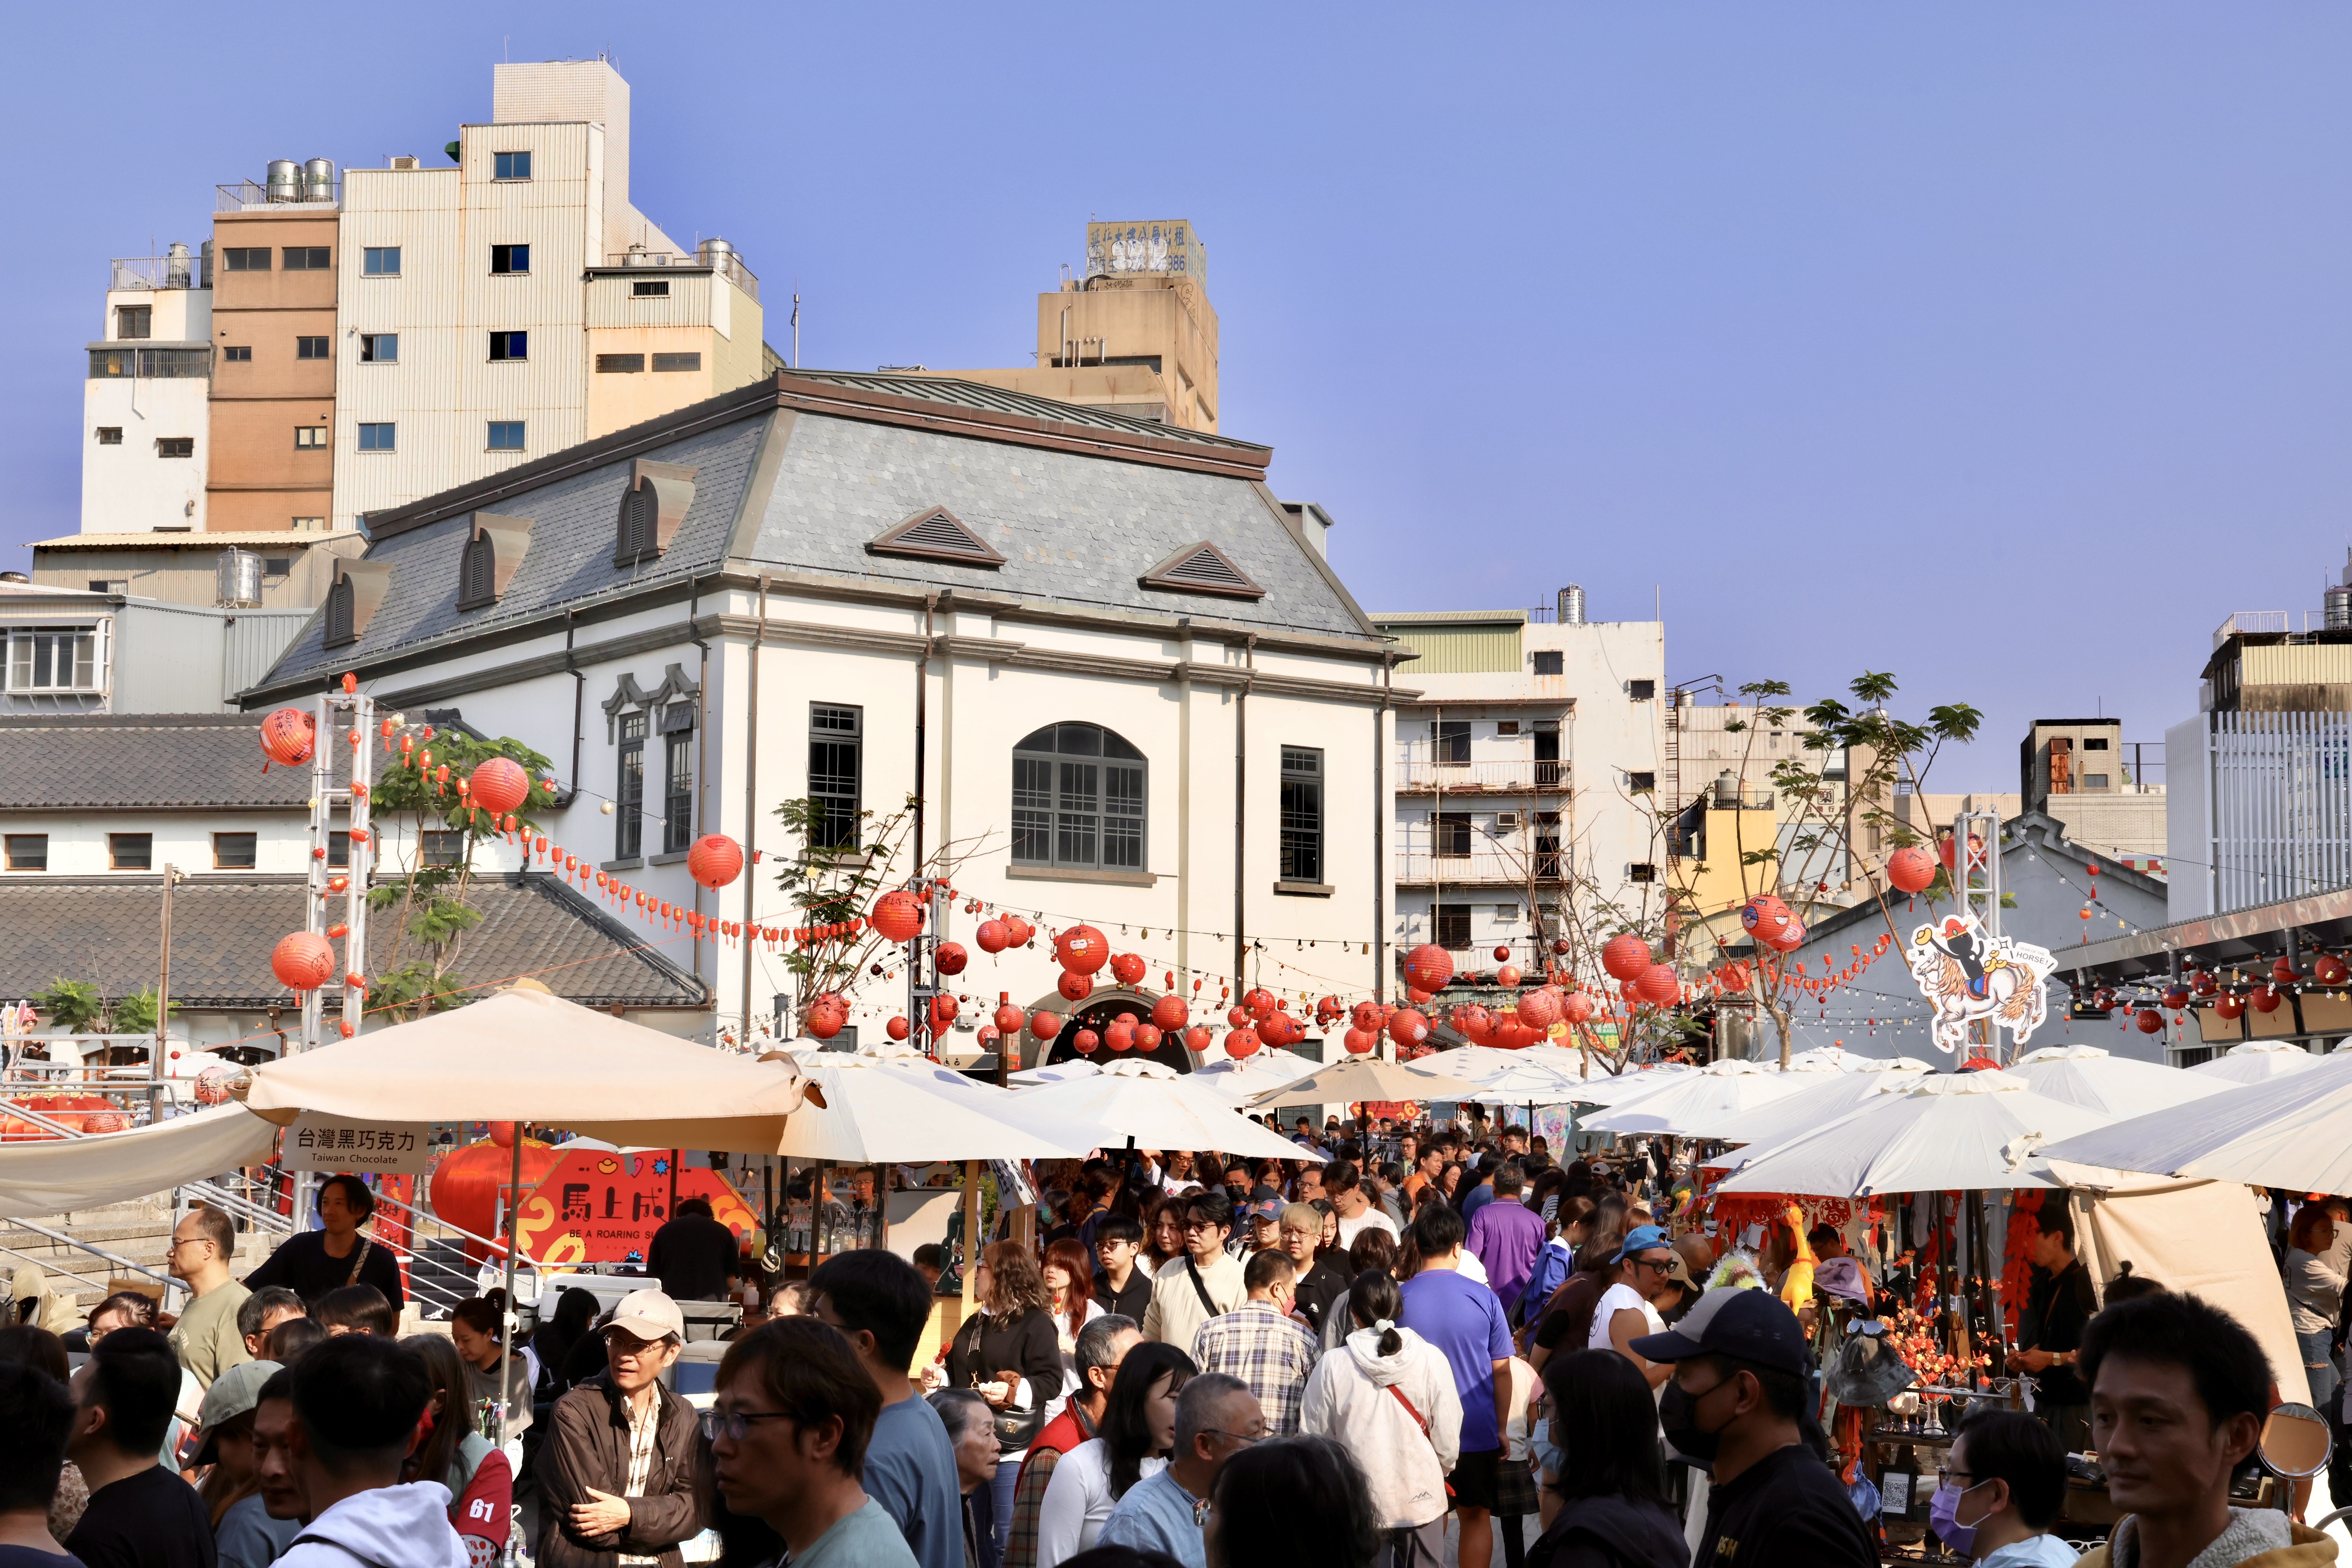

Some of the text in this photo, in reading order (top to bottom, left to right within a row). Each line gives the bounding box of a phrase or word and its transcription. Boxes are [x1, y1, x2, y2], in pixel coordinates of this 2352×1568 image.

[2016, 951, 2048, 965] HORSE!
[298, 1128, 414, 1151] 台灣黑巧克力
[312, 1153, 398, 1164] Taiwan Chocolate
[562, 1183, 709, 1222] 馬上成
[596, 1230, 640, 1239] ROARING
[469, 1499, 495, 1523] 61
